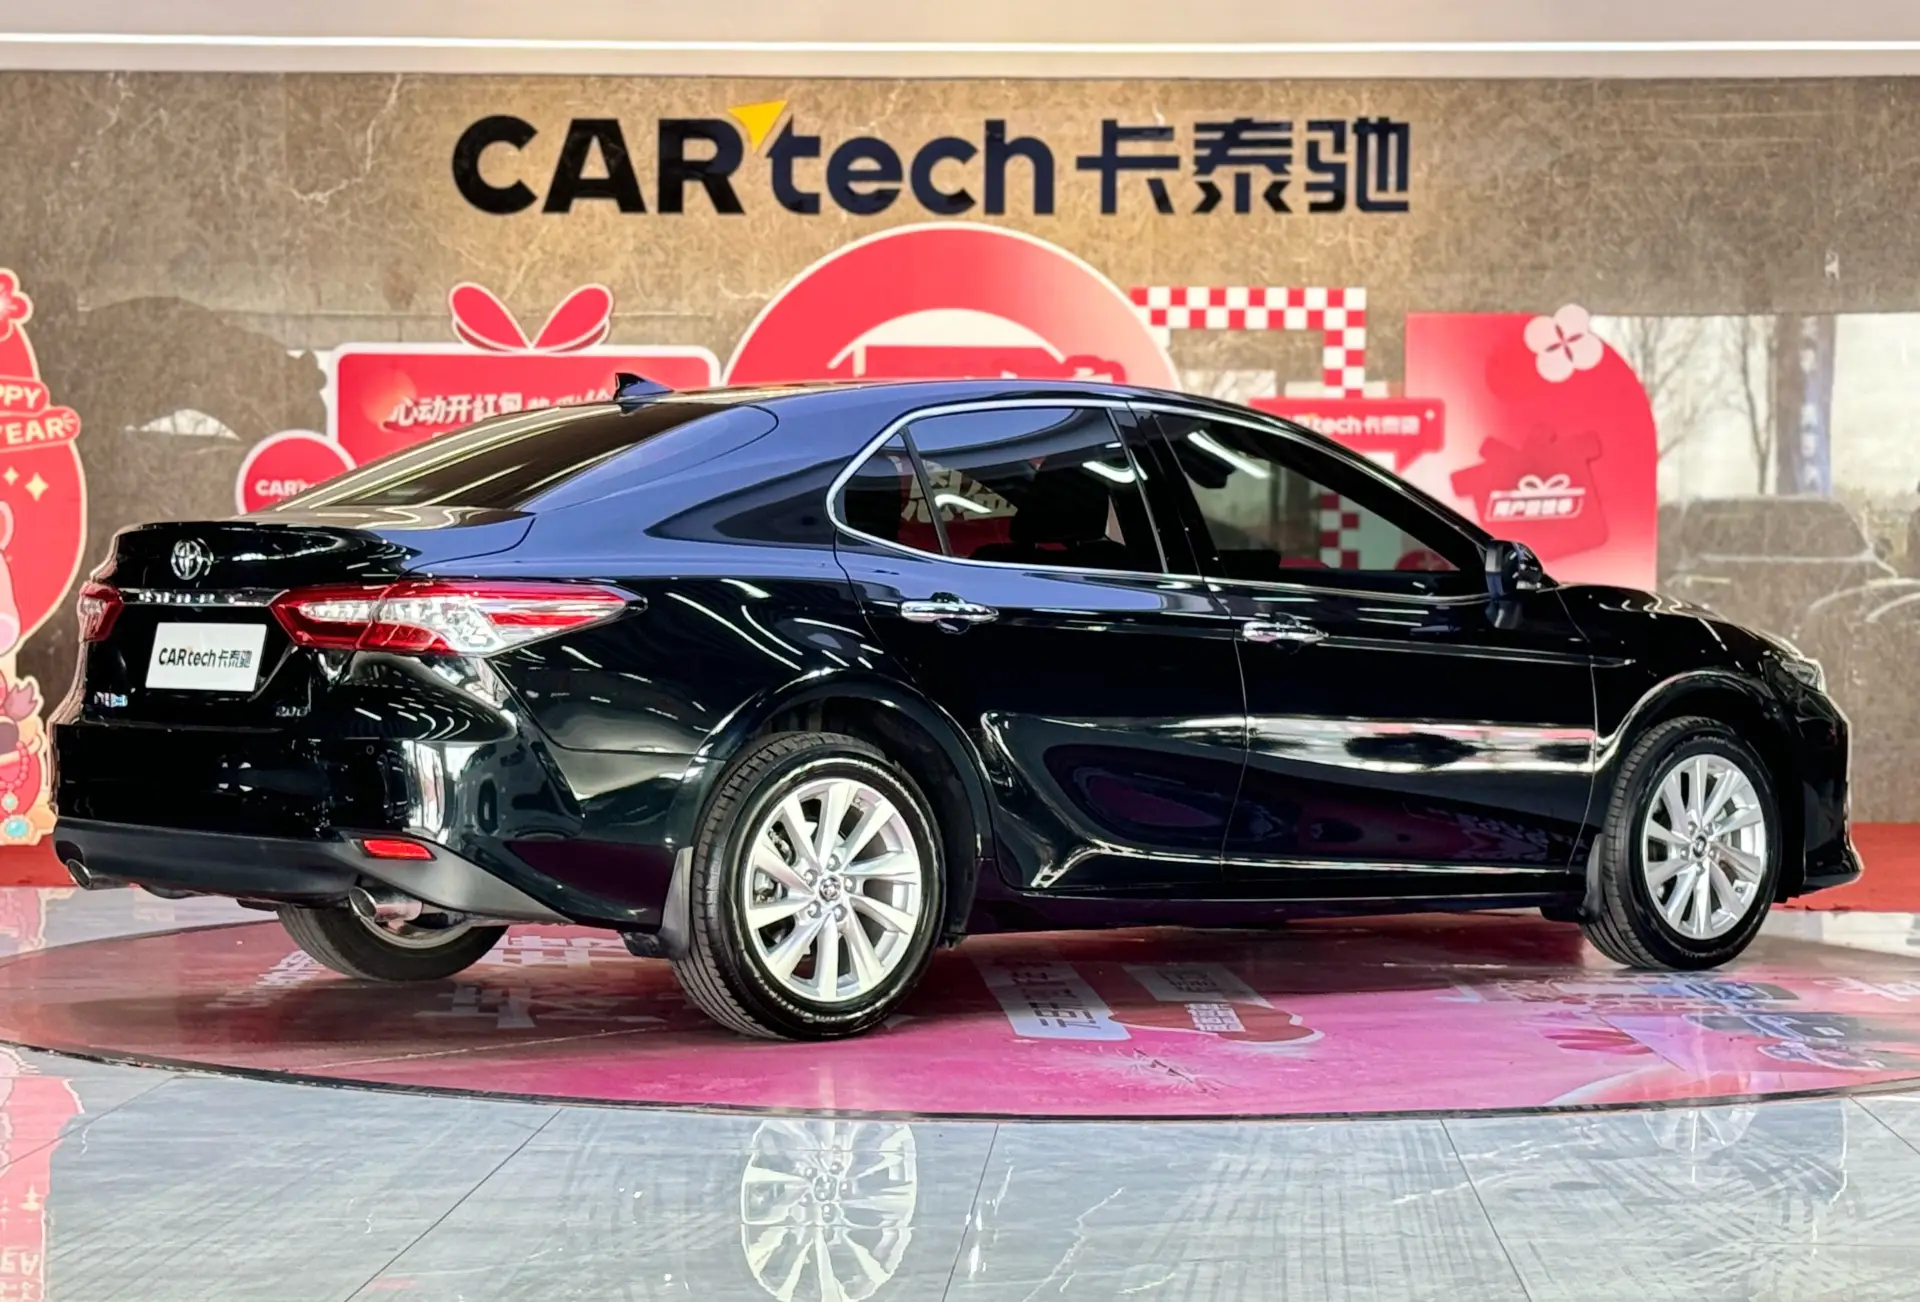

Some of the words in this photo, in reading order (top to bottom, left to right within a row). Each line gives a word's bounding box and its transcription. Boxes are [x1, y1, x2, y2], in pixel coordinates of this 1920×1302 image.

[452, 115, 1054, 214] CARtech
[1076, 117, 1411, 214] 卡泰驰
[158, 647, 217, 668] CARtech
